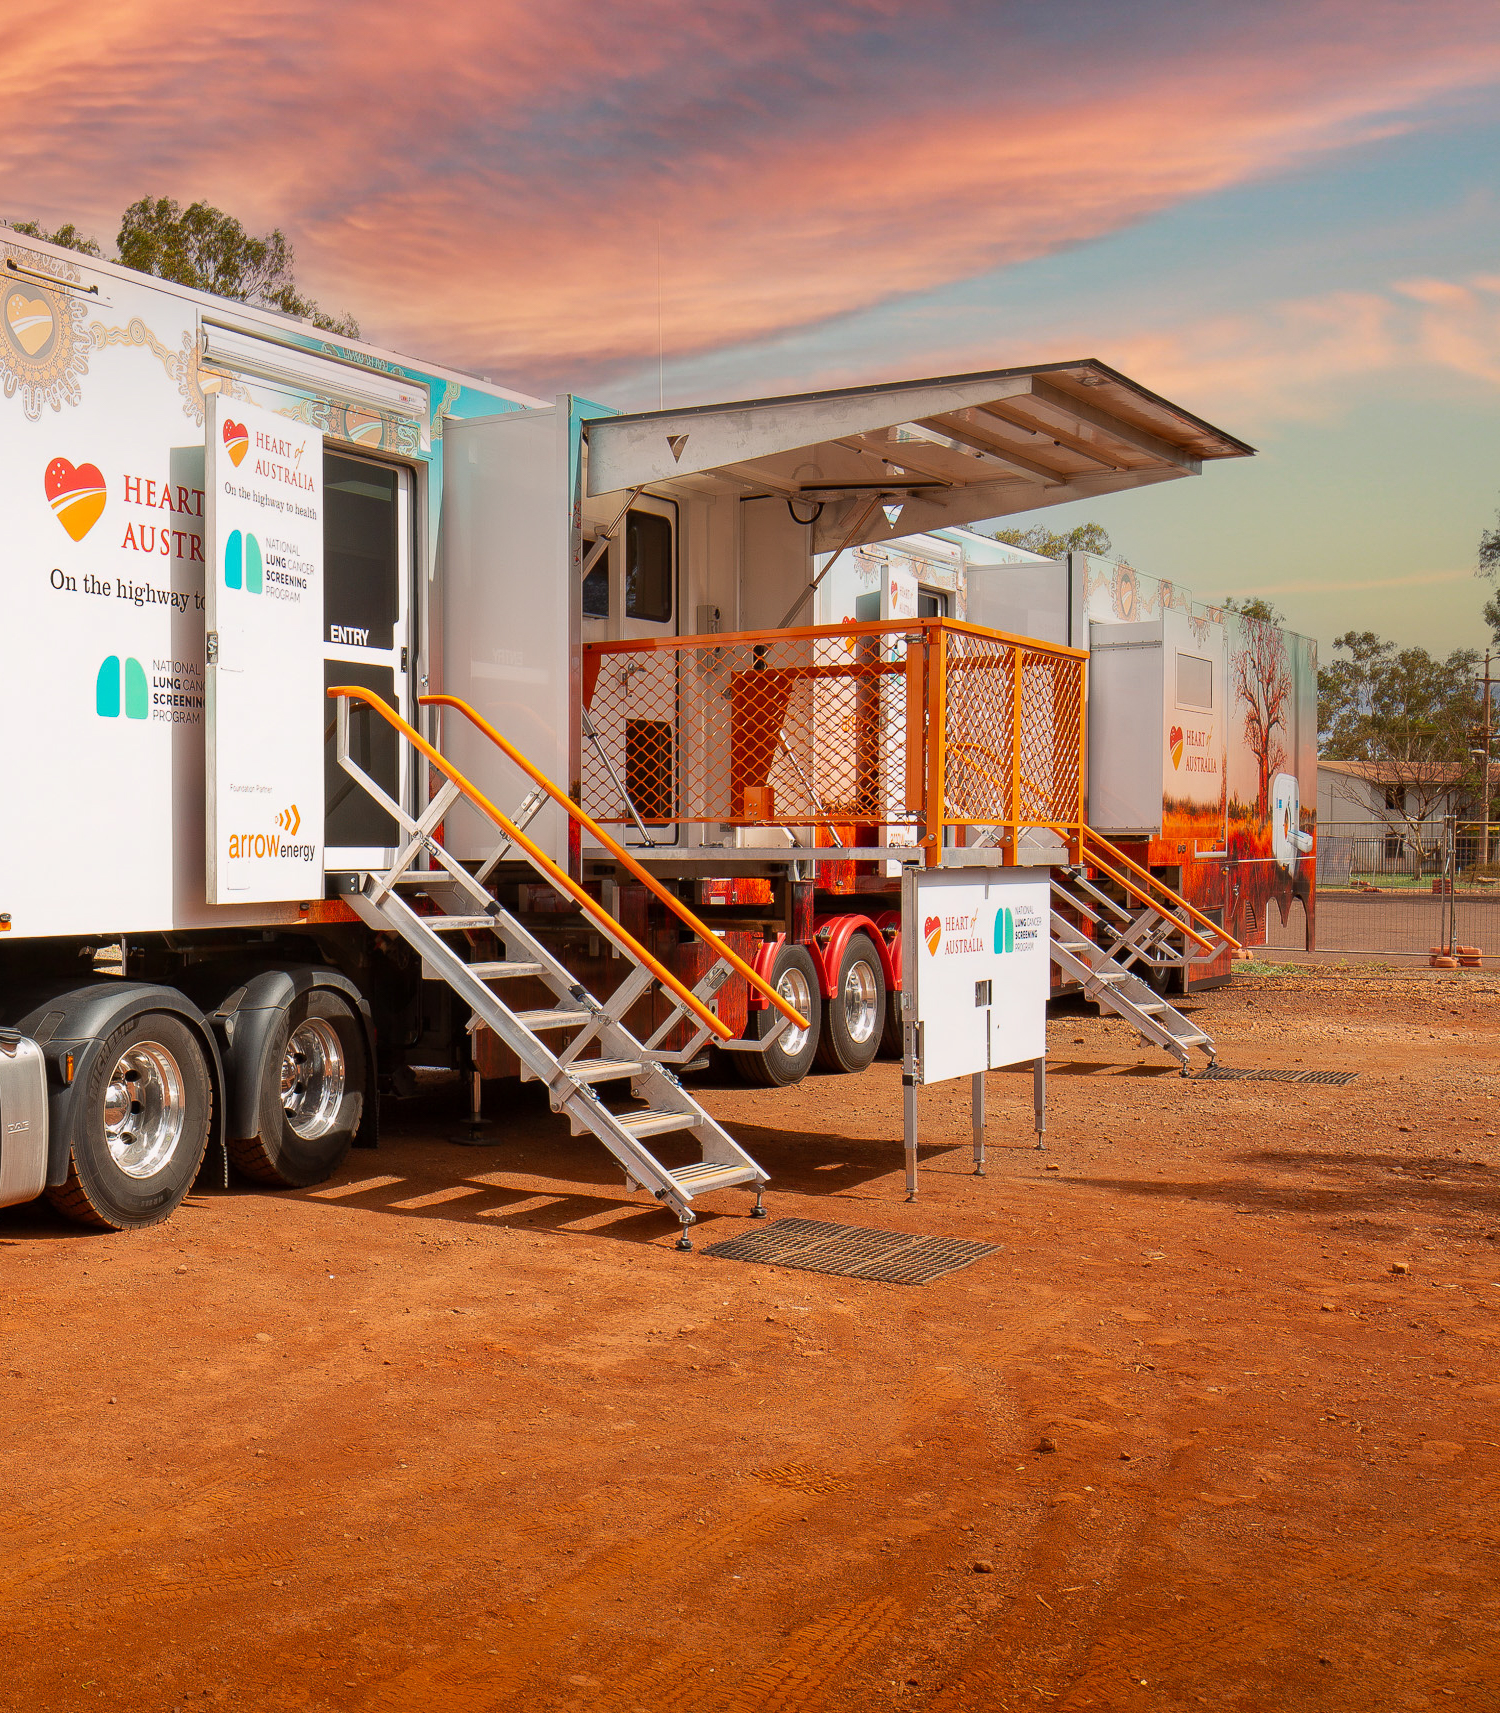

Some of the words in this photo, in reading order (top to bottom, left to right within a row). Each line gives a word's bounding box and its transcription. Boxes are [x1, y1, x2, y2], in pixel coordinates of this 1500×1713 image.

[255, 431, 292, 458] HEART
[294, 440, 306, 470] of
[255, 459, 315, 492] AUSTRALIA
[123, 474, 205, 517] HEART
[224, 481, 237, 496] On
[238, 486, 251, 500] the
[252, 490, 285, 513] highway
[286, 501, 294, 513] to
[295, 503, 317, 520] health
[120, 521, 205, 563] AUSTR
[265, 537, 301, 557] NATIONAL
[265, 553, 287, 569] LUNG
[287, 558, 315, 576] CANCER
[265, 569, 307, 589] SCREENING
[50, 568, 77, 592] On
[83, 573, 111, 597] the
[116, 578, 190, 613] highway
[265, 585, 301, 604] PROGRAM
[330, 624, 370, 646] ENTRY
[152, 659, 202, 676] NATIONAL
[153, 676, 181, 690] LUNG
[182, 679, 205, 692] CAN
[152, 709, 201, 724] PROGRAM
[1186, 729, 1206, 747] HEART
[1185, 755, 1218, 773] AUSTRALIA
[228, 833, 281, 860] arrow
[280, 844, 316, 862] energy
[1014, 905, 1035, 916] NATIONAL
[945, 915, 970, 932] HEART
[970, 907, 979, 938] of
[1014, 918, 1027, 928] LUNG
[1026, 916, 1043, 927] CANCER
[1014, 929, 1038, 940] SCREENING
[944, 937, 984, 956] AUSTRALIA
[1014, 941, 1035, 952] PROGRAM
